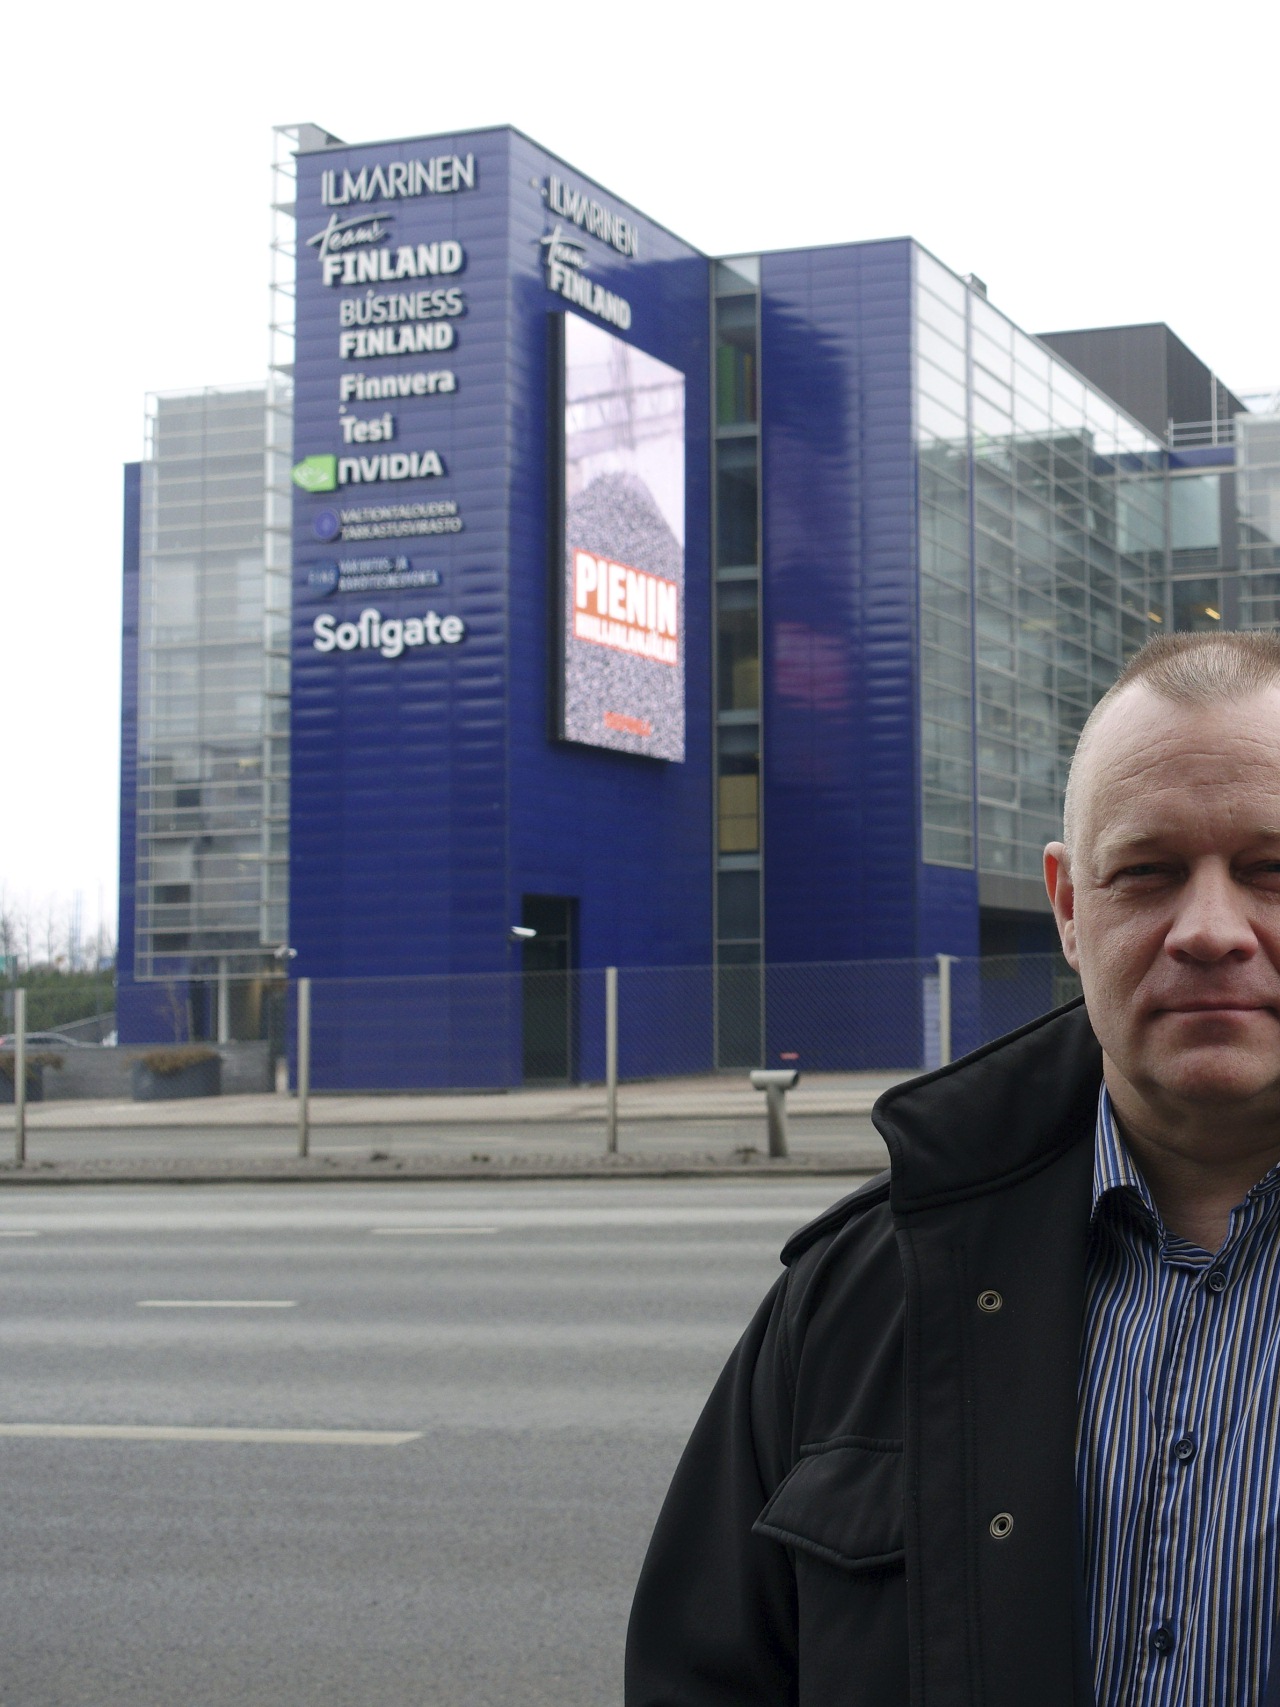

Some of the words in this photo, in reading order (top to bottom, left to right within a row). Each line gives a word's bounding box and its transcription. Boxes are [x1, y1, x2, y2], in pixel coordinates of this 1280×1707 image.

[321, 153, 474, 205] ILMARINEN
[550, 175, 638, 258] ILMARINEN
[322, 240, 463, 286] FINLAND
[549, 262, 631, 330] FINLAND
[339, 321, 453, 359] FINLAND
[339, 370, 455, 401] Finnvera
[339, 411, 393, 444] Tesi
[576, 552, 677, 637] PIENIN
[313, 608, 464, 658] Sofigate
